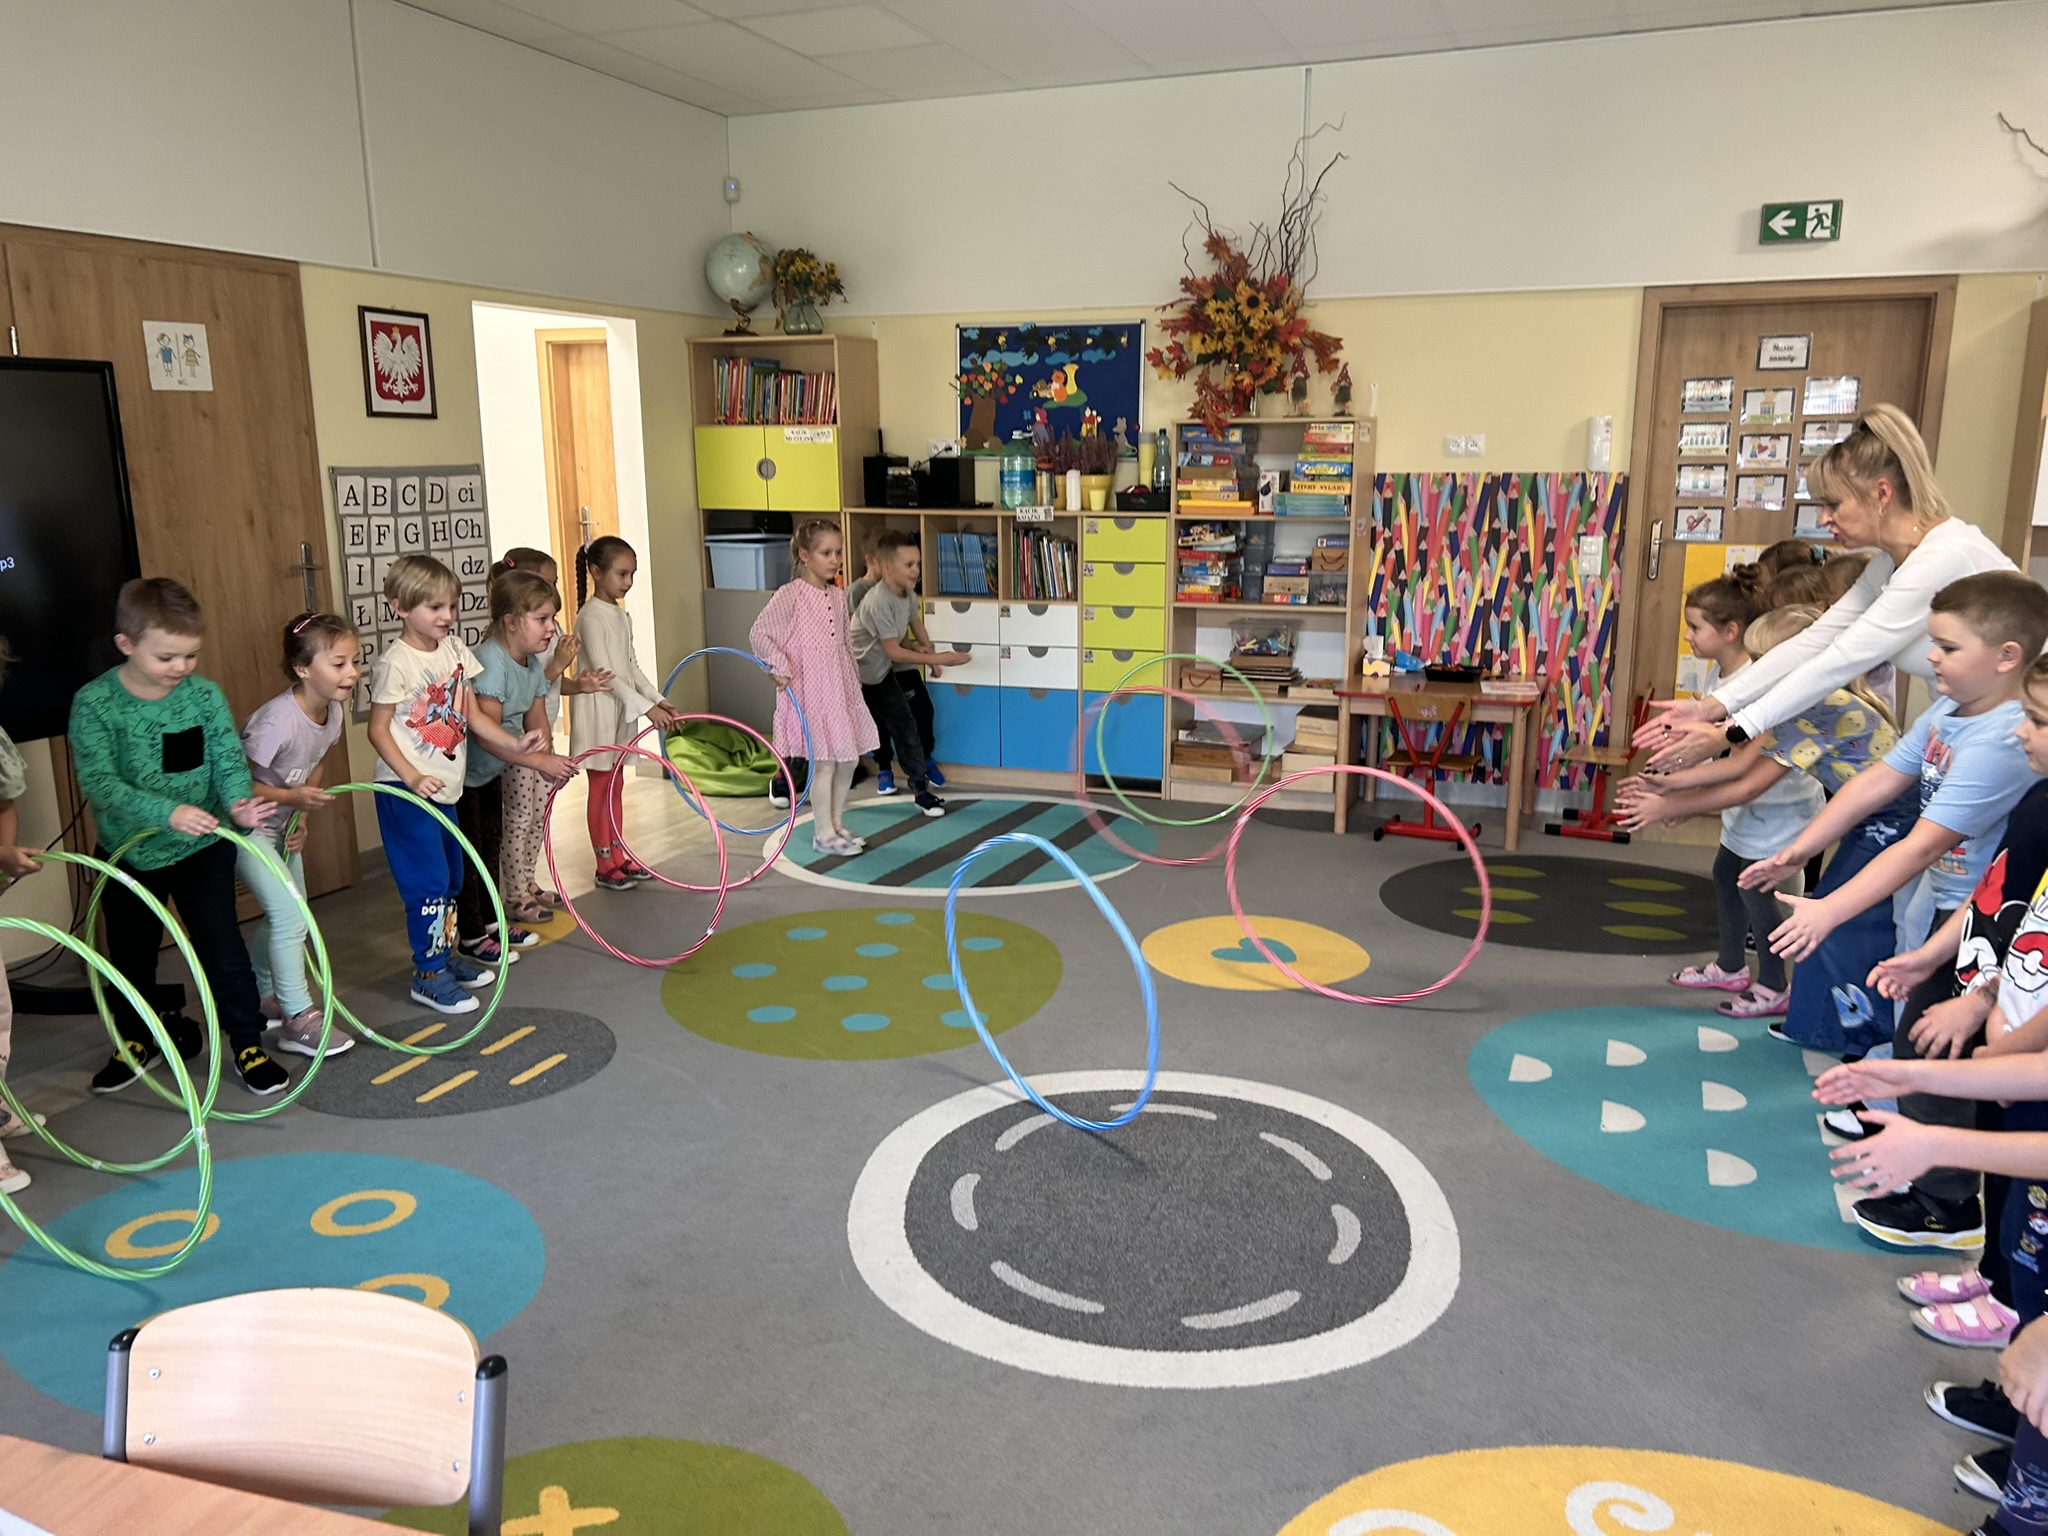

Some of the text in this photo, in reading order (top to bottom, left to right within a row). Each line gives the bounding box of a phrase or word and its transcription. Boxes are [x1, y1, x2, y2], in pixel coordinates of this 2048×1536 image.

[343, 482, 475, 506] A B C D ci
[350, 518, 482, 546] E F G H Ch
[356, 555, 485, 586] I dz
[357, 605, 371, 626] Ł
[460, 592, 488, 612] Dz
[362, 643, 374, 665] P
